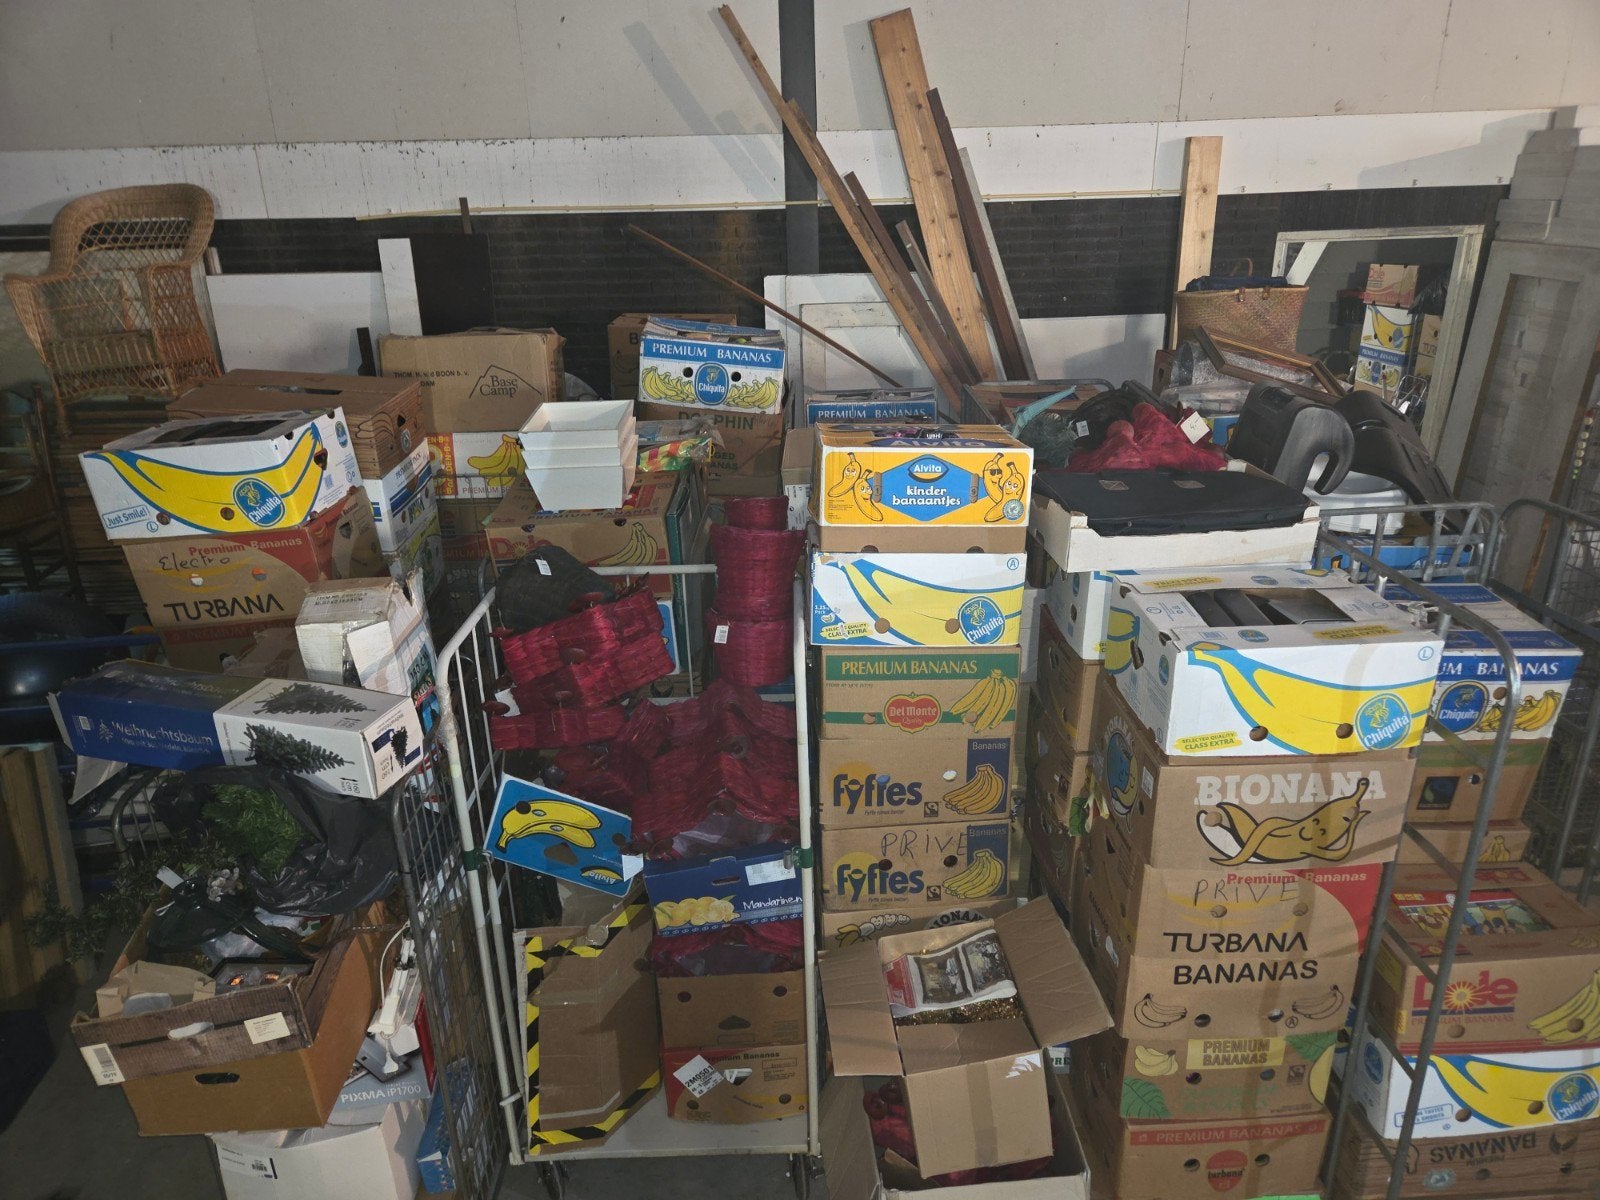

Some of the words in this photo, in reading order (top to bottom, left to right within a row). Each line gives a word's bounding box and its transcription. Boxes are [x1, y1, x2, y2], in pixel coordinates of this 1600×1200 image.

[652, 343, 707, 358] PREMIUM
[717, 348, 772, 363] BANANAS
[490, 375, 518, 387] Base
[479, 384, 517, 398] Camp
[698, 382, 726, 395] Chiquita
[818, 410, 867, 419] PREMIUM
[914, 463, 942, 473] Alvita
[906, 485, 947, 496] kinder
[892, 495, 961, 508] banaantjes
[247, 495, 282, 523] Chiquita
[107, 515, 122, 527] Just
[122, 508, 148, 523] Smile!
[189, 543, 245, 556] Premium
[251, 537, 302, 549] Bananas
[158, 552, 231, 572] Electro
[163, 593, 285, 622] TURBANA
[847, 627, 868, 636] EXTRA
[967, 616, 1005, 642] Chiquita
[841, 660, 907, 676] PREMIUM
[911, 660, 978, 675] BANANAS
[890, 706, 905, 717] Del
[907, 705, 937, 716] Monte
[1438, 708, 1480, 721] Chiquita
[1364, 713, 1411, 748] Chiquita
[1182, 736, 1208, 744] SELECTED
[1209, 732, 1235, 740] QUALITY
[1184, 741, 1209, 751] CLASS
[1209, 737, 1235, 747] EXTRA
[972, 741, 1008, 751] Bananas
[1194, 770, 1387, 806] BIONANA
[969, 828, 1008, 837] Bananas
[588, 871, 616, 884] Alvita
[1226, 873, 1296, 885] Premium
[1305, 871, 1368, 883] Bananas
[1193, 879, 1300, 907] PRIVE
[743, 896, 803, 911] Mandarinen
[1163, 931, 1309, 953] TURBANA
[1173, 959, 1319, 985] BANANAS
[1466, 1014, 1515, 1024] BANANAS
[1203, 1038, 1271, 1054] PREMIUM
[743, 1051, 780, 1060] Bananas
[1203, 1052, 1268, 1066] BANANAS
[685, 1065, 715, 1088] 2M0501
[340, 1089, 387, 1104] PIXMA
[387, 1084, 421, 1097] iP1700
[1556, 1089, 1600, 1120] Chiquita
[1156, 1128, 1225, 1143] PREMIUM
[1229, 1124, 1301, 1141] BANANAS
[1430, 1131, 1538, 1164] BANANAS
[1207, 1168, 1244, 1180] turbana
